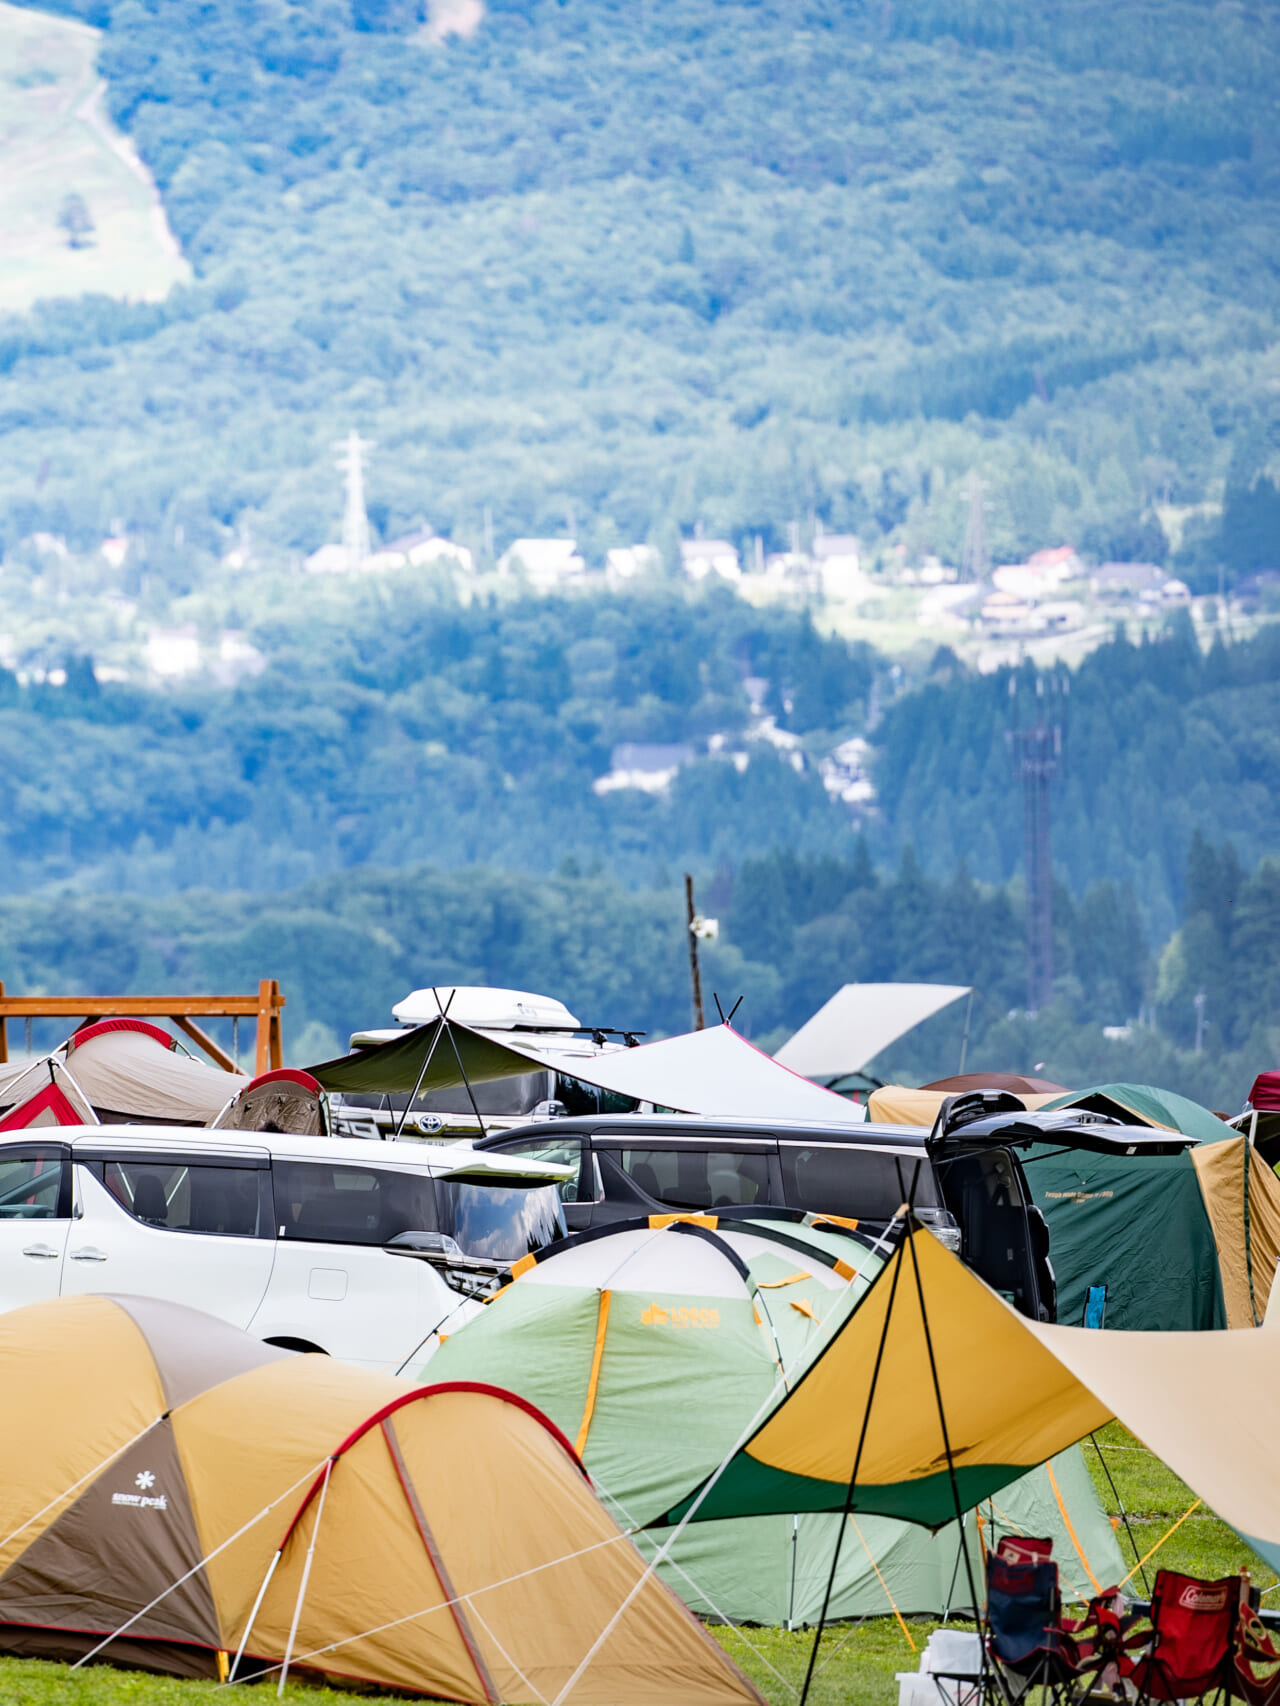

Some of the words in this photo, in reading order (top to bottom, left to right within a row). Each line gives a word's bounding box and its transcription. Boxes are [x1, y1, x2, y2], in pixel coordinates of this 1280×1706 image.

[671, 1306, 720, 1323] LOGOS
[112, 1492, 141, 1503] snow
[140, 1494, 168, 1508] peak
